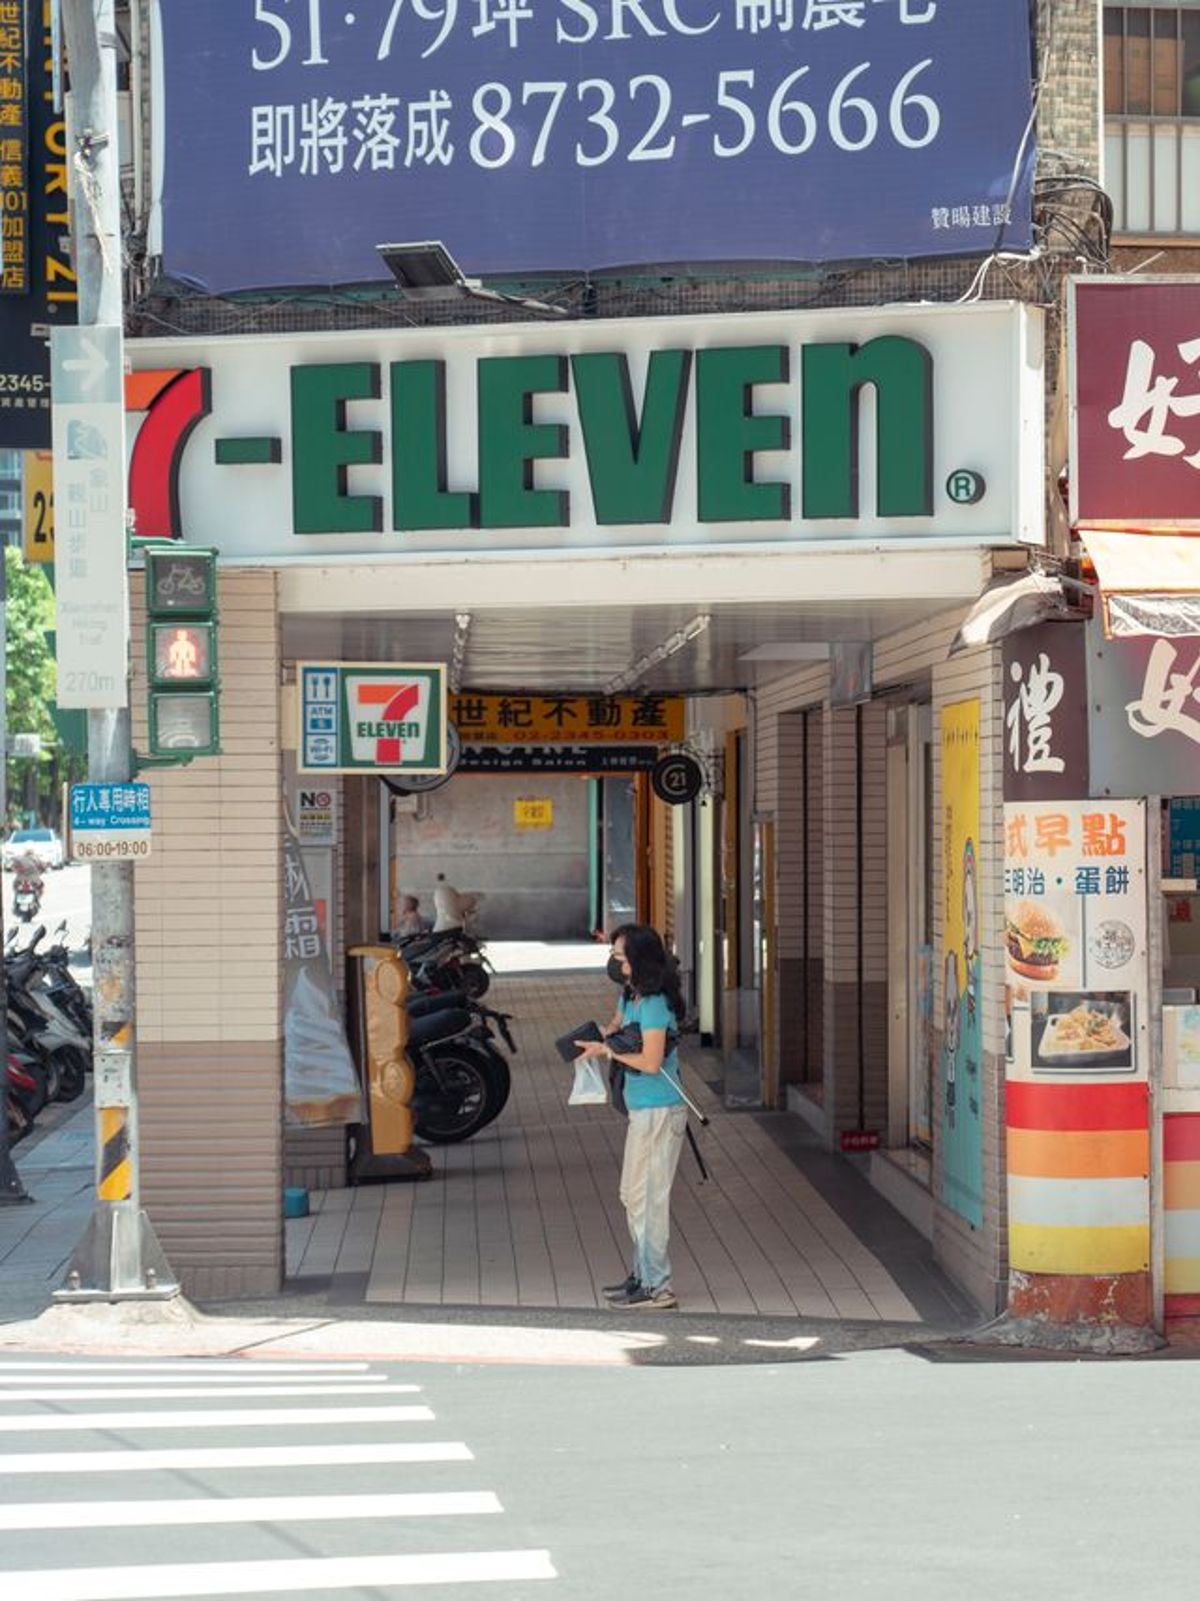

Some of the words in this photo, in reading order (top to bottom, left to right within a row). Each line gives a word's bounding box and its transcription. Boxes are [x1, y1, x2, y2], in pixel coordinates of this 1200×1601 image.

[249, 90, 454, 177] 即將落成
[469, 59, 941, 168] 8732-5666
[33, 491, 54, 544] 2
[65, 672, 115, 692] 270m
[310, 706, 333, 717] ATM
[452, 697, 667, 727] 世紀不動產
[1007, 653, 1066, 774] 禮
[78, 841, 148, 856] 06:00-19:00
